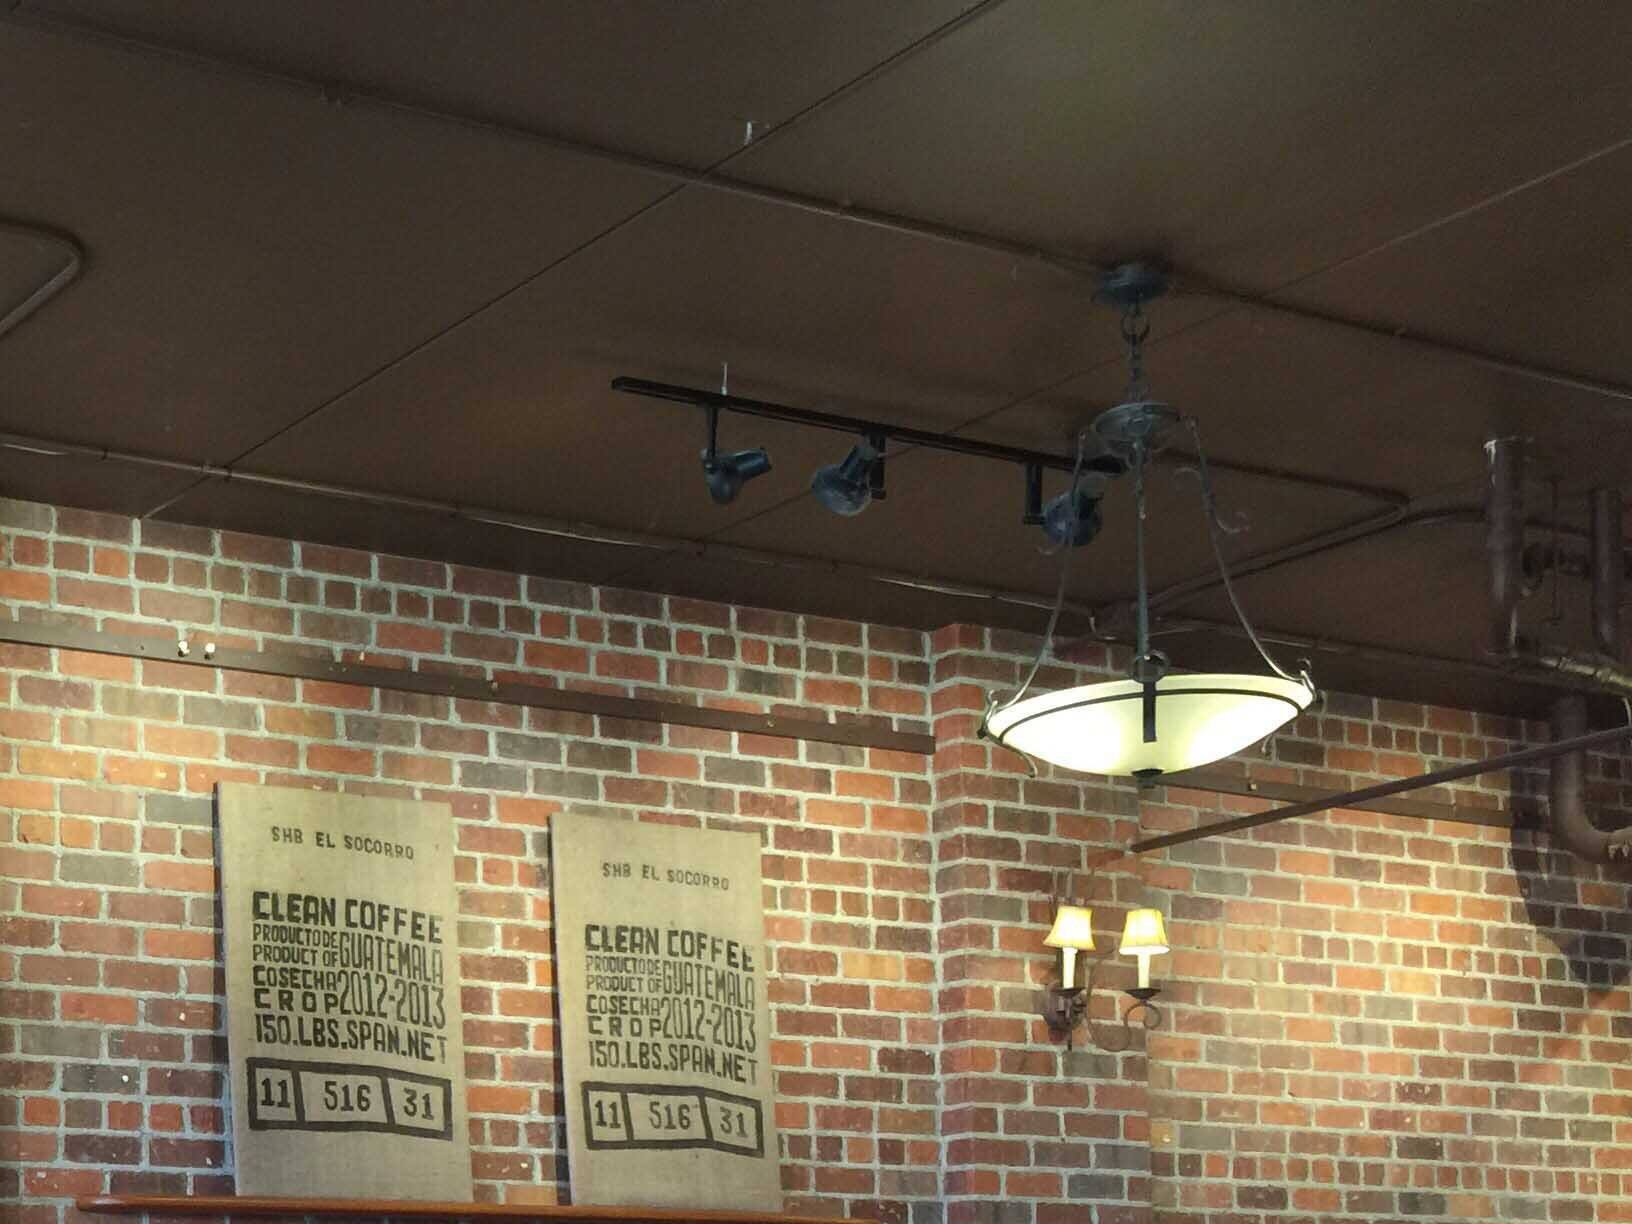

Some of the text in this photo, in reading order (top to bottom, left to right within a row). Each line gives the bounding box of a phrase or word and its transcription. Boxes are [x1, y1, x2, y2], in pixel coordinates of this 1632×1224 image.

[271, 826, 414, 860] SHB EL SOCORRO
[602, 862, 729, 891] SHB EL SOCORRO
[252, 891, 443, 944] CLEAN COFFEE
[253, 944, 339, 967] PRODUCT OF
[339, 930, 444, 985] GUATEMALA
[585, 924, 755, 972] CLEAN COFFEE
[253, 965, 337, 991] COSECHA
[586, 975, 662, 993] PRODUCT OF
[663, 959, 755, 1010] GUATEMALA
[254, 988, 338, 1014] CROP
[338, 971, 446, 1030] 2012-2013
[586, 994, 661, 1017] COSECHA
[588, 1016, 662, 1038] CROP
[661, 997, 757, 1054] 2012-2013
[260, 1078, 291, 1108] 11
[324, 1081, 371, 1112] 516
[403, 1087, 434, 1120] 31
[594, 1100, 621, 1129] 11
[649, 1101, 691, 1130] 516
[719, 1107, 748, 1138] 31
